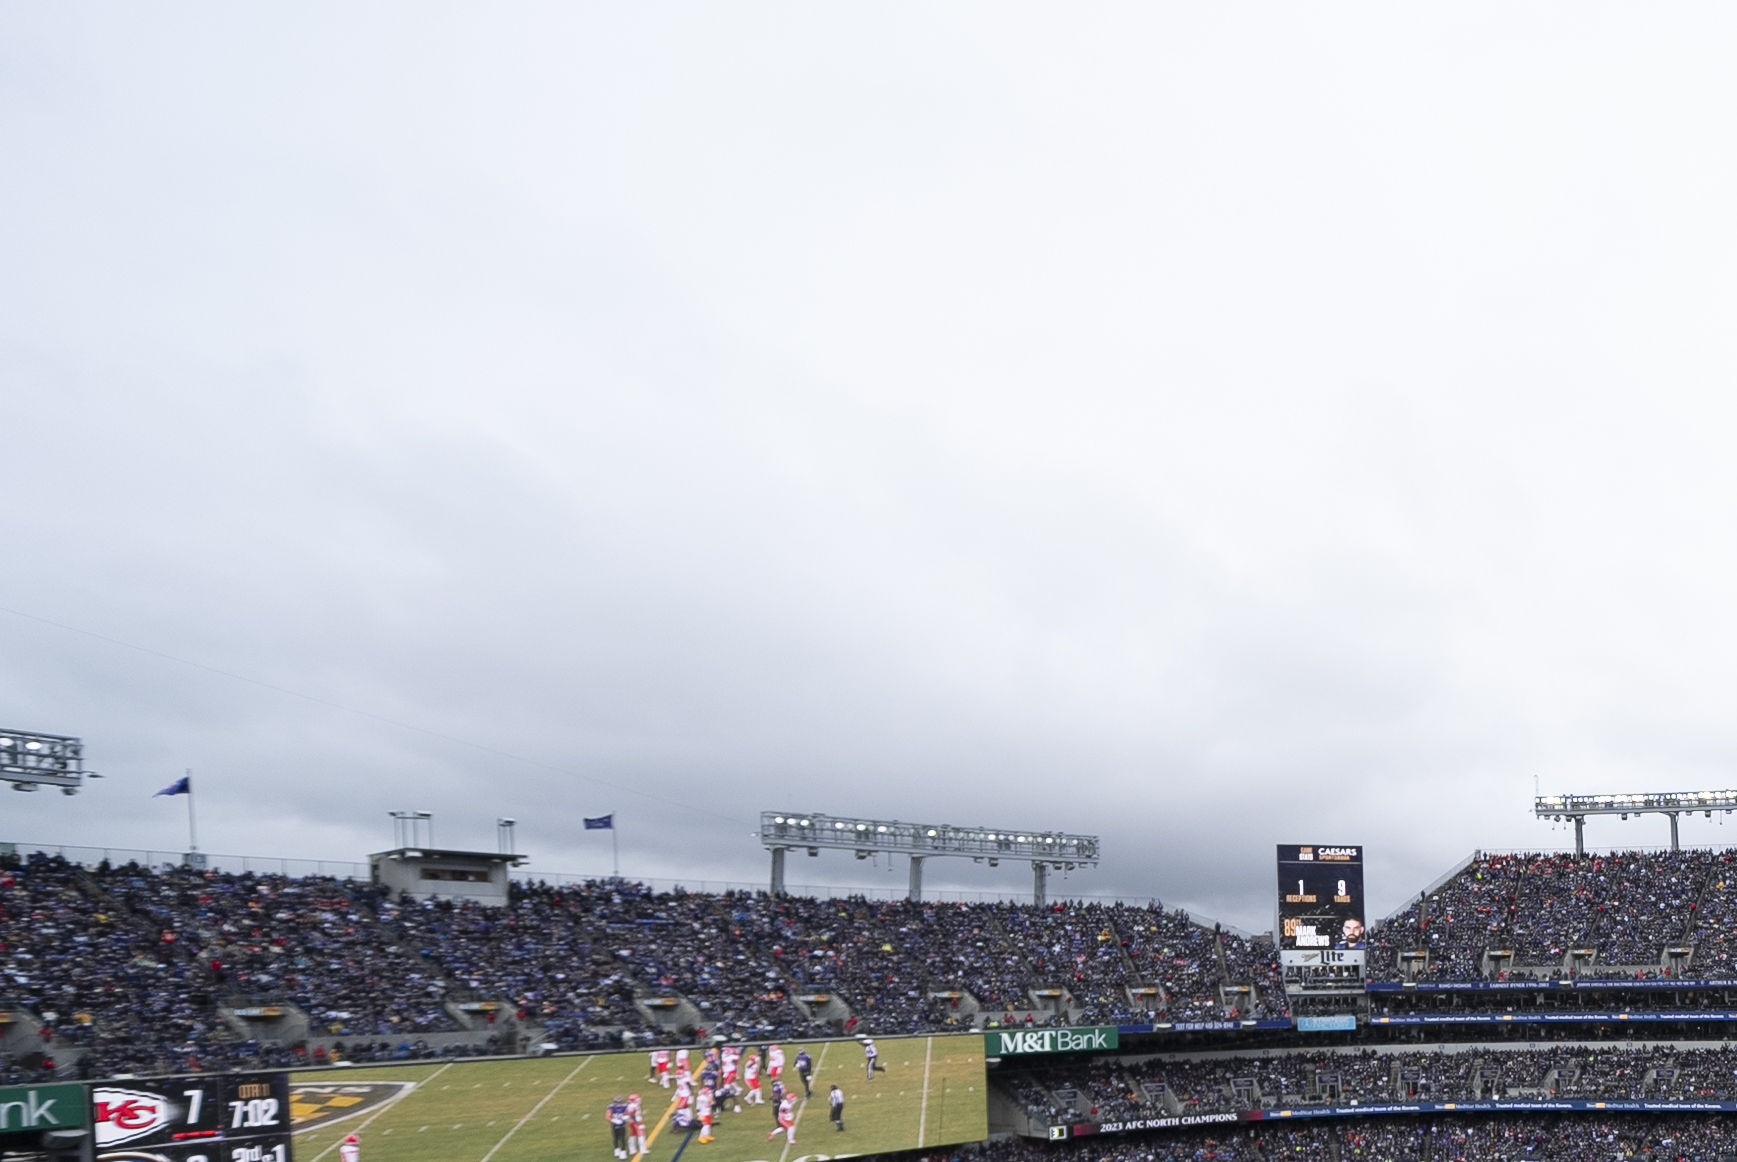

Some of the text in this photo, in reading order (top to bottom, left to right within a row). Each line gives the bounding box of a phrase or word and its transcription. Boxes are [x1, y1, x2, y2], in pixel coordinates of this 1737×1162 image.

[1318, 847, 1357, 856] CAESARS
[1297, 879, 1304, 895] 1
[1337, 880, 1346, 896] 9
[1286, 894, 1317, 903] RECEPTIONS
[1284, 918, 1296, 937] 89
[1295, 925, 1317, 936] MARK
[1295, 935, 1330, 947] ANDREWS
[1320, 951, 1344, 965] Lite
[998, 1029, 1108, 1054] M&T Bank
[184, 1089, 203, 1124] 7
[229, 1098, 280, 1129] 7:02
[1100, 1113, 1238, 1132] 2023 AFC NORTH CHAMPIONS
